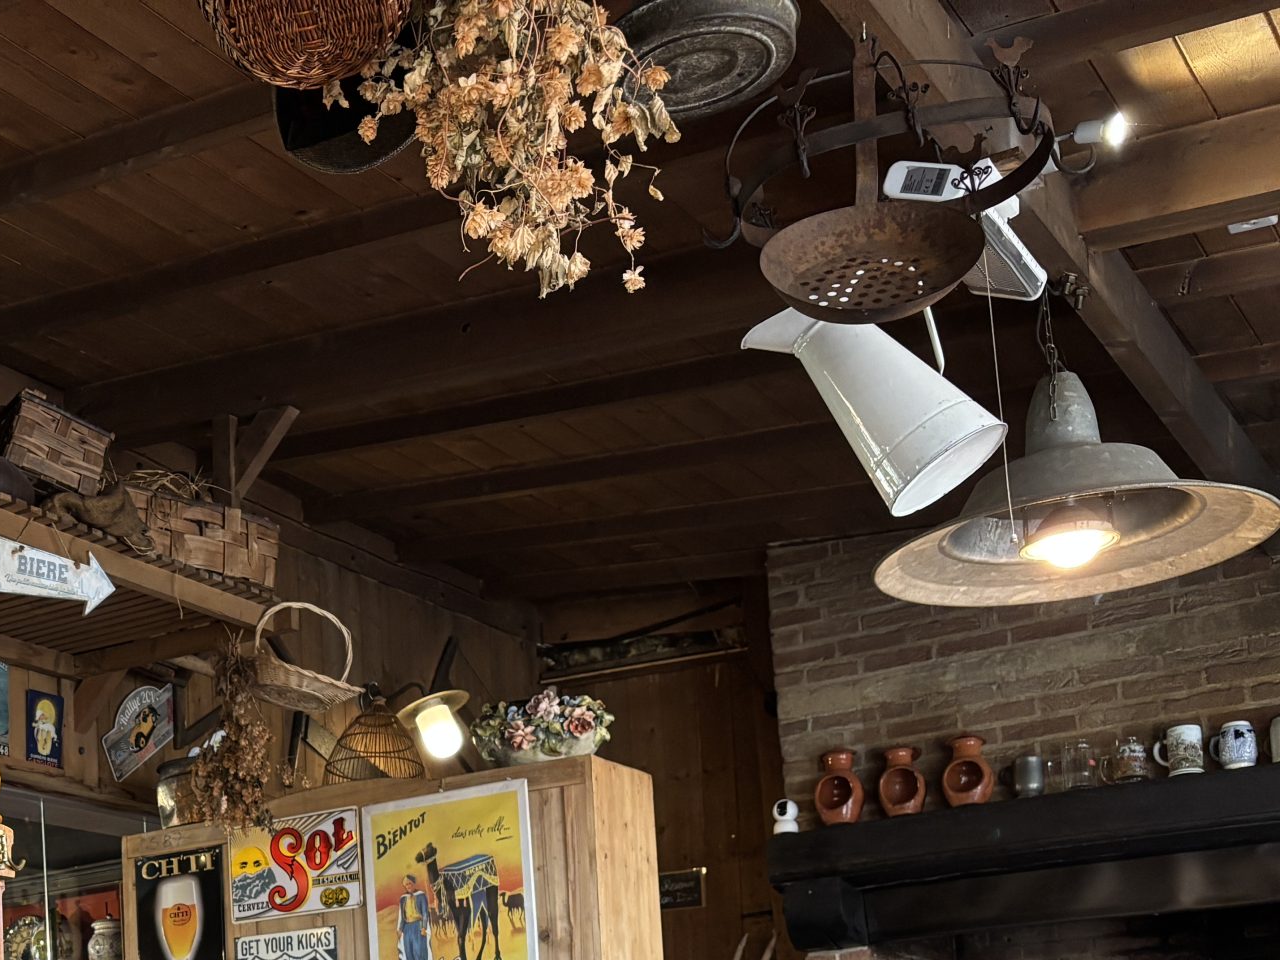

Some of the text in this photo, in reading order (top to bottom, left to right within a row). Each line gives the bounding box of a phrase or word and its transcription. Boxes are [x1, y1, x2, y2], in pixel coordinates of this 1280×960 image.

[17, 554, 69, 585] BIERE
[268, 816, 354, 912] SOL
[237, 900, 270, 913] CERVEZA
[241, 931, 331, 957] GET YOUR KICKS
